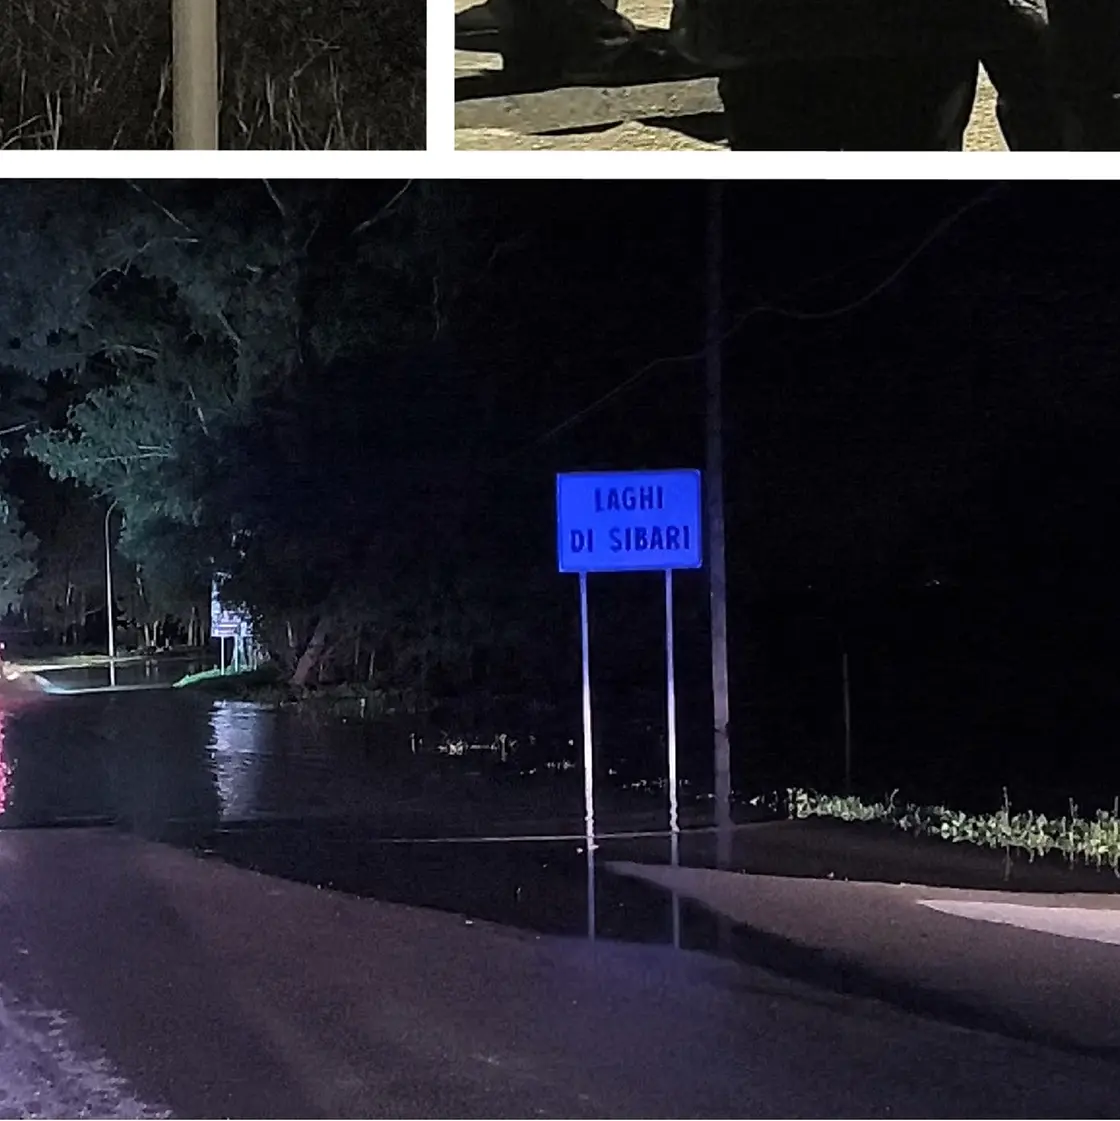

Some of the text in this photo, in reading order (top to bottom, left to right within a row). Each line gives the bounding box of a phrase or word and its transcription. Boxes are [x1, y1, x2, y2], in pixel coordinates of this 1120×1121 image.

[594, 485, 664, 513] LAGHI
[570, 525, 690, 553] DI SIBARI
